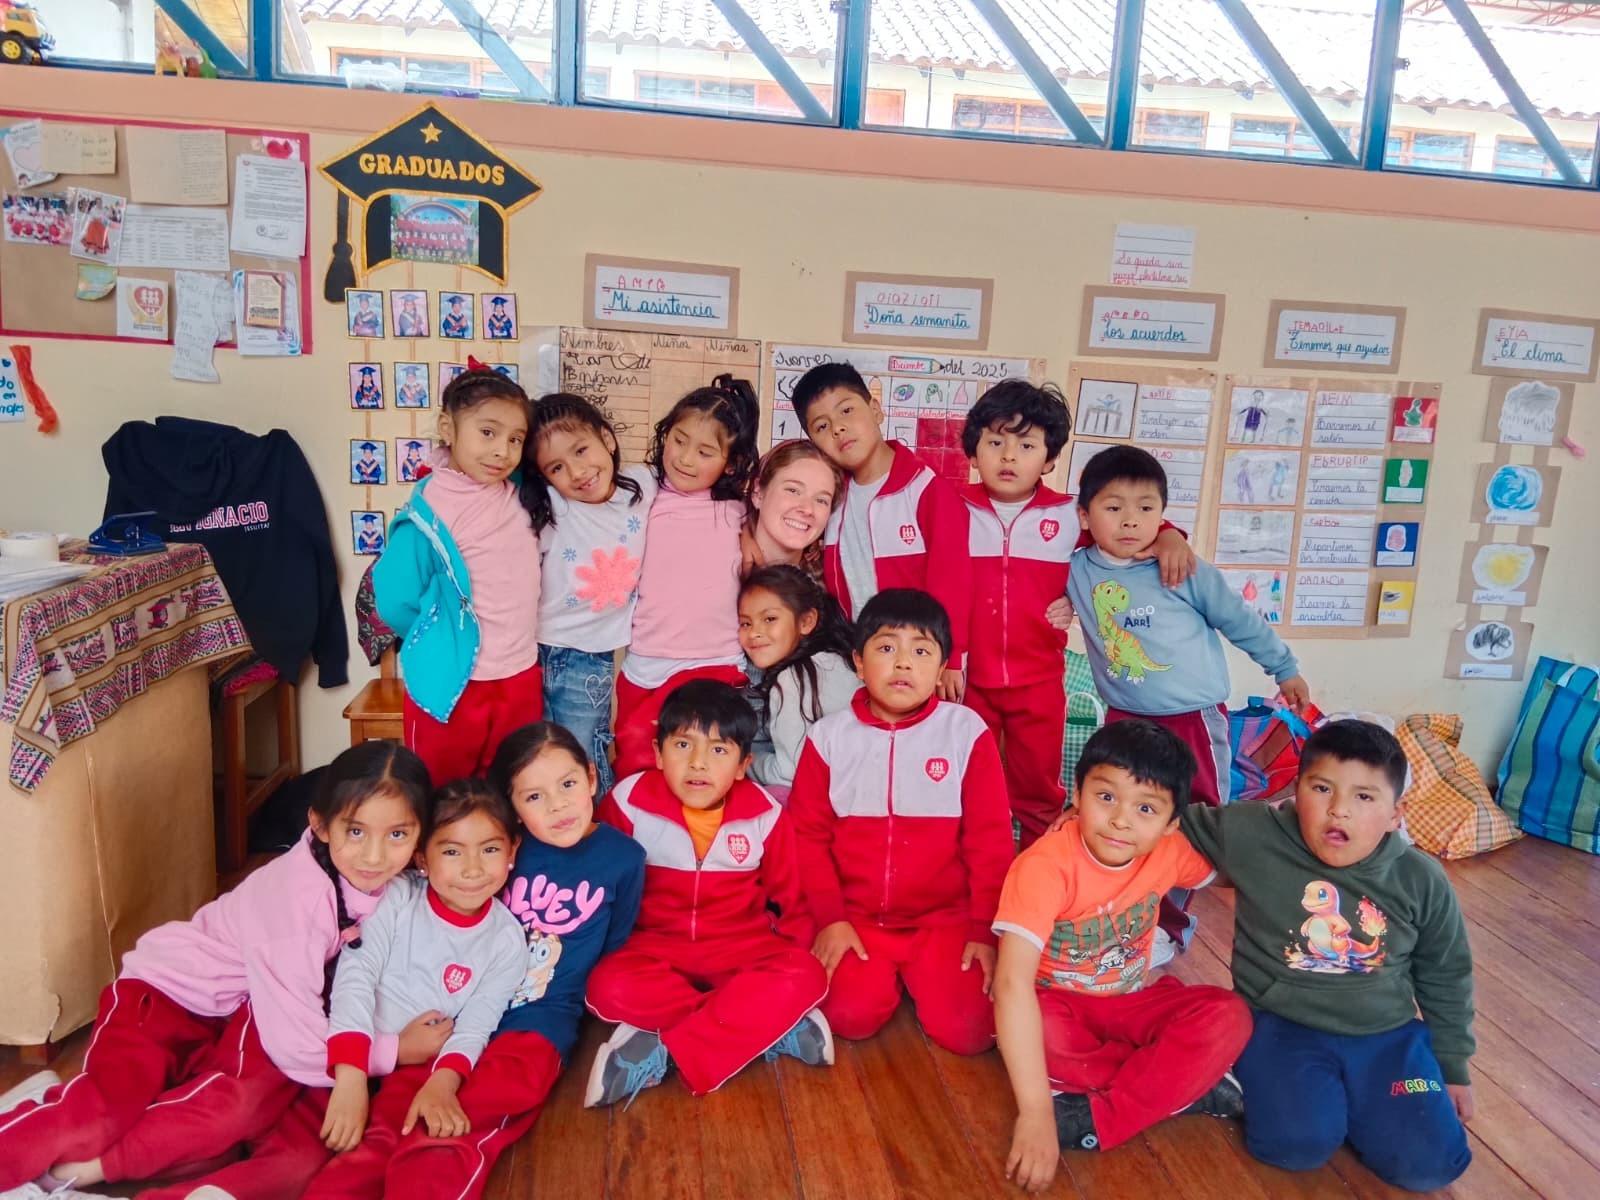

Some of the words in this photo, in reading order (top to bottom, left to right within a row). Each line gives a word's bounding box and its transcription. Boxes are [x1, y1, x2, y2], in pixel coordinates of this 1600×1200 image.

[359, 152, 505, 186] GRADUADOS
[608, 290, 632, 312] Mi
[636, 295, 717, 318] asistencia
[867, 305, 905, 325] Doña
[911, 312, 971, 330] semanita
[561, 332, 625, 352] Nombres
[653, 335, 692, 350] Niños
[1130, 324, 1188, 342] acuerdos
[706, 339, 749, 353] Niñas
[1354, 344, 1392, 360] ayudar
[1501, 338, 1518, 358] El
[1522, 343, 1567, 364] clima
[972, 361, 1009, 378] 2025
[778, 420, 786, 436] 1
[503, 874, 605, 935] LUEY
